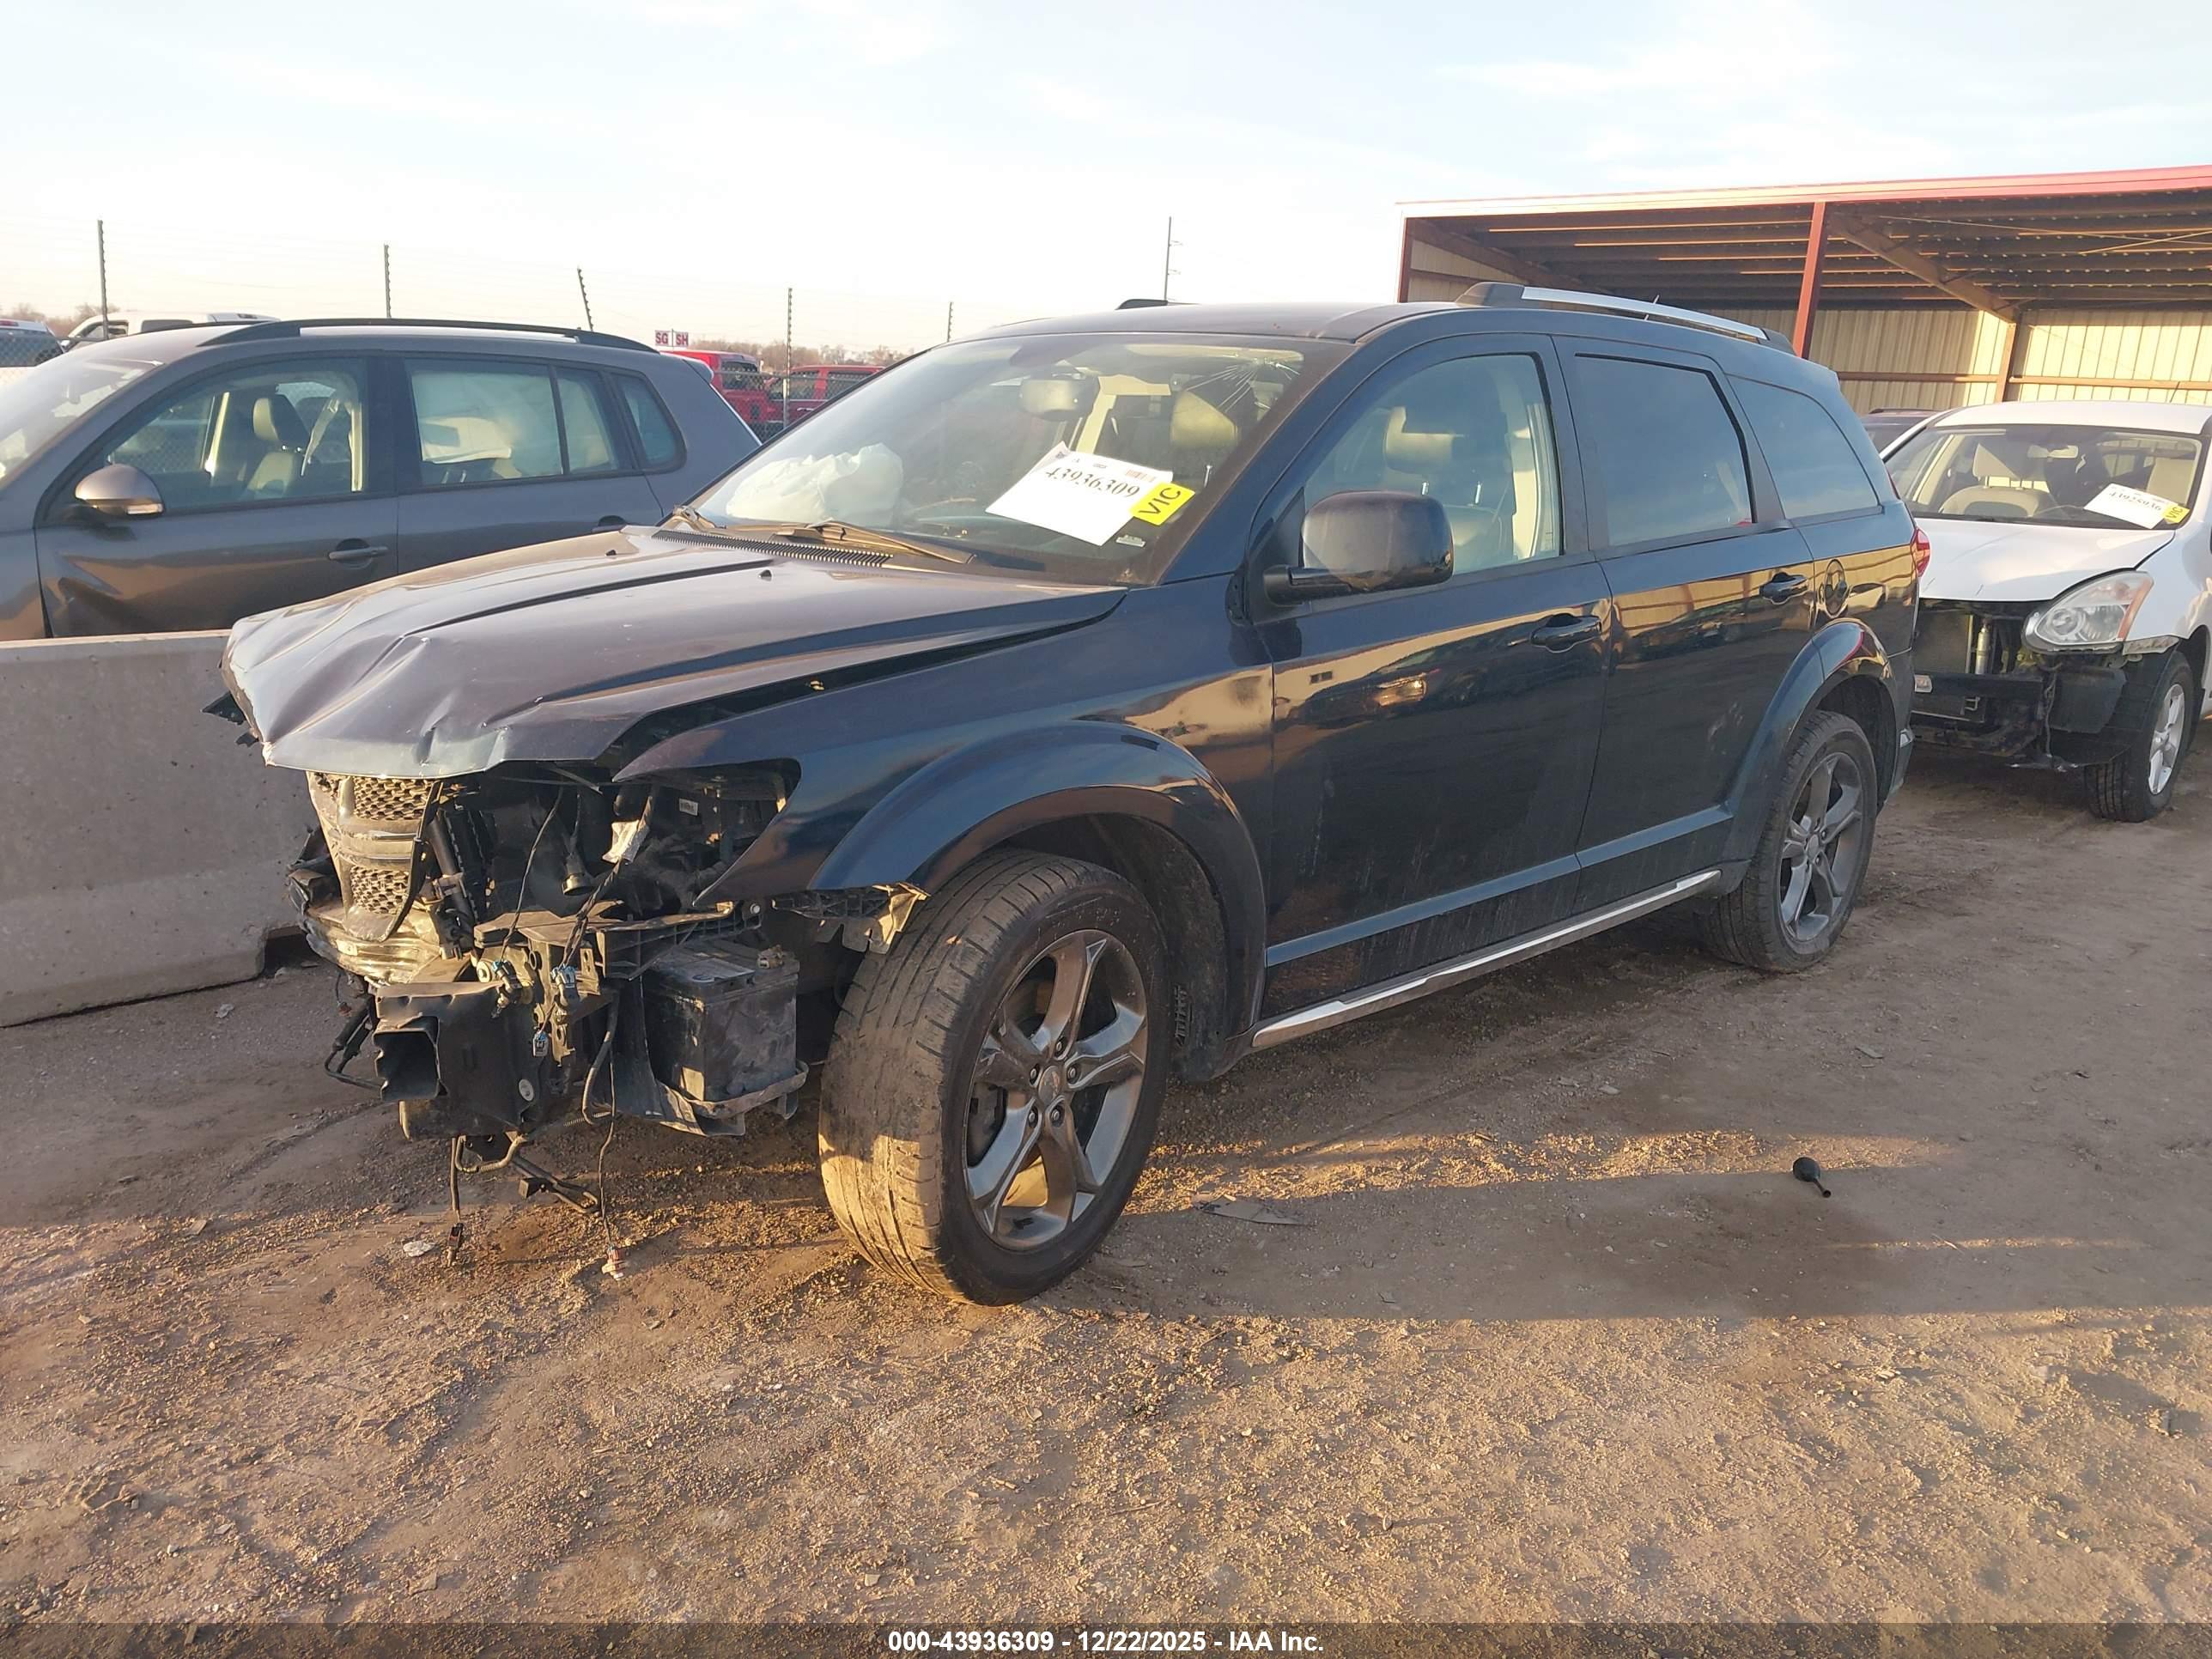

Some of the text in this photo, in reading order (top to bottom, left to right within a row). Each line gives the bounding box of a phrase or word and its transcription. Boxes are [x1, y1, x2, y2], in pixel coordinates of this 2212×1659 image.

[655, 331, 668, 344] SG
[676, 333, 689, 345] SH
[1045, 466, 1140, 498] 43936309
[1139, 487, 1182, 515] VIC
[2166, 507, 2184, 519] VIC
